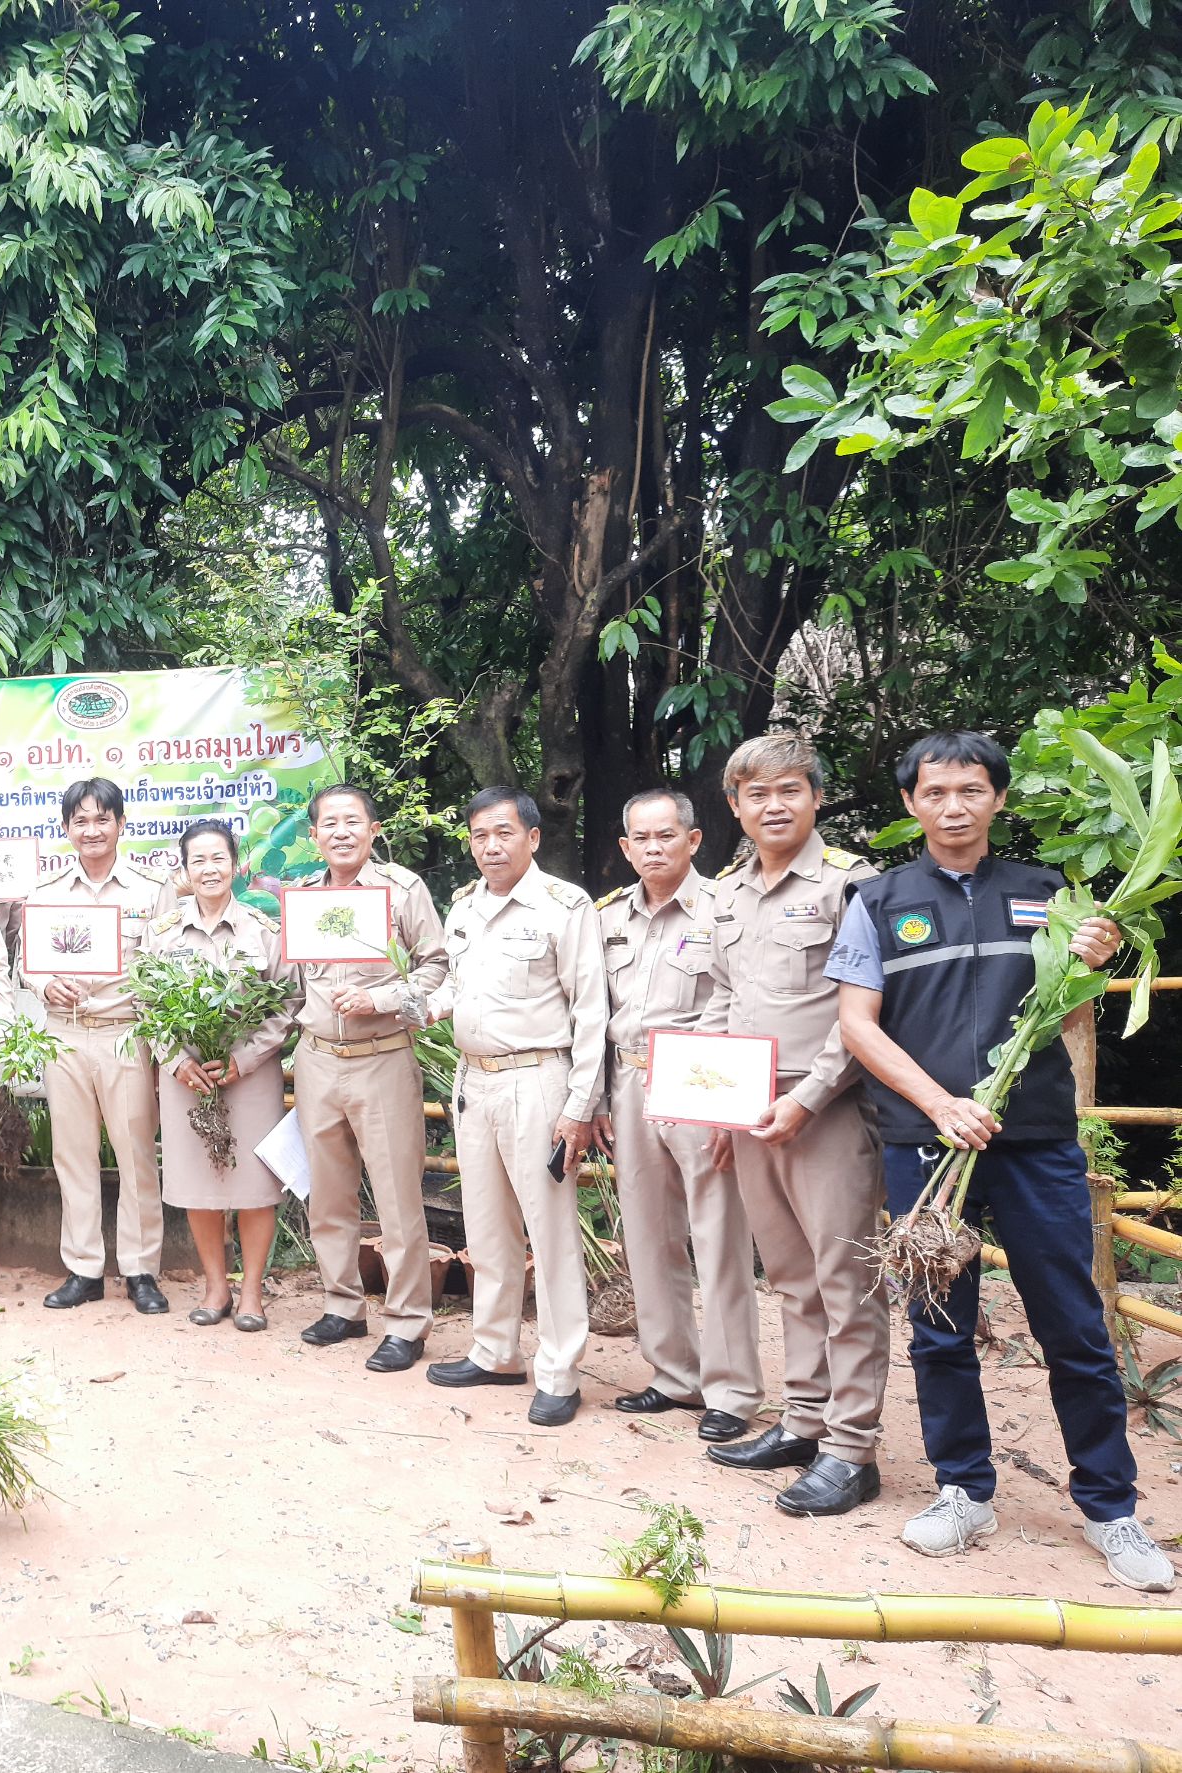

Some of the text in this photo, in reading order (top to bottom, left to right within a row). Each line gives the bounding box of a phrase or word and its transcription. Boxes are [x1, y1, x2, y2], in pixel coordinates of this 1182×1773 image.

[27, 738, 92, 766] อปท.
[105, 746, 123, 763] ๑
[137, 723, 302, 769] สวนสมุนไพร
